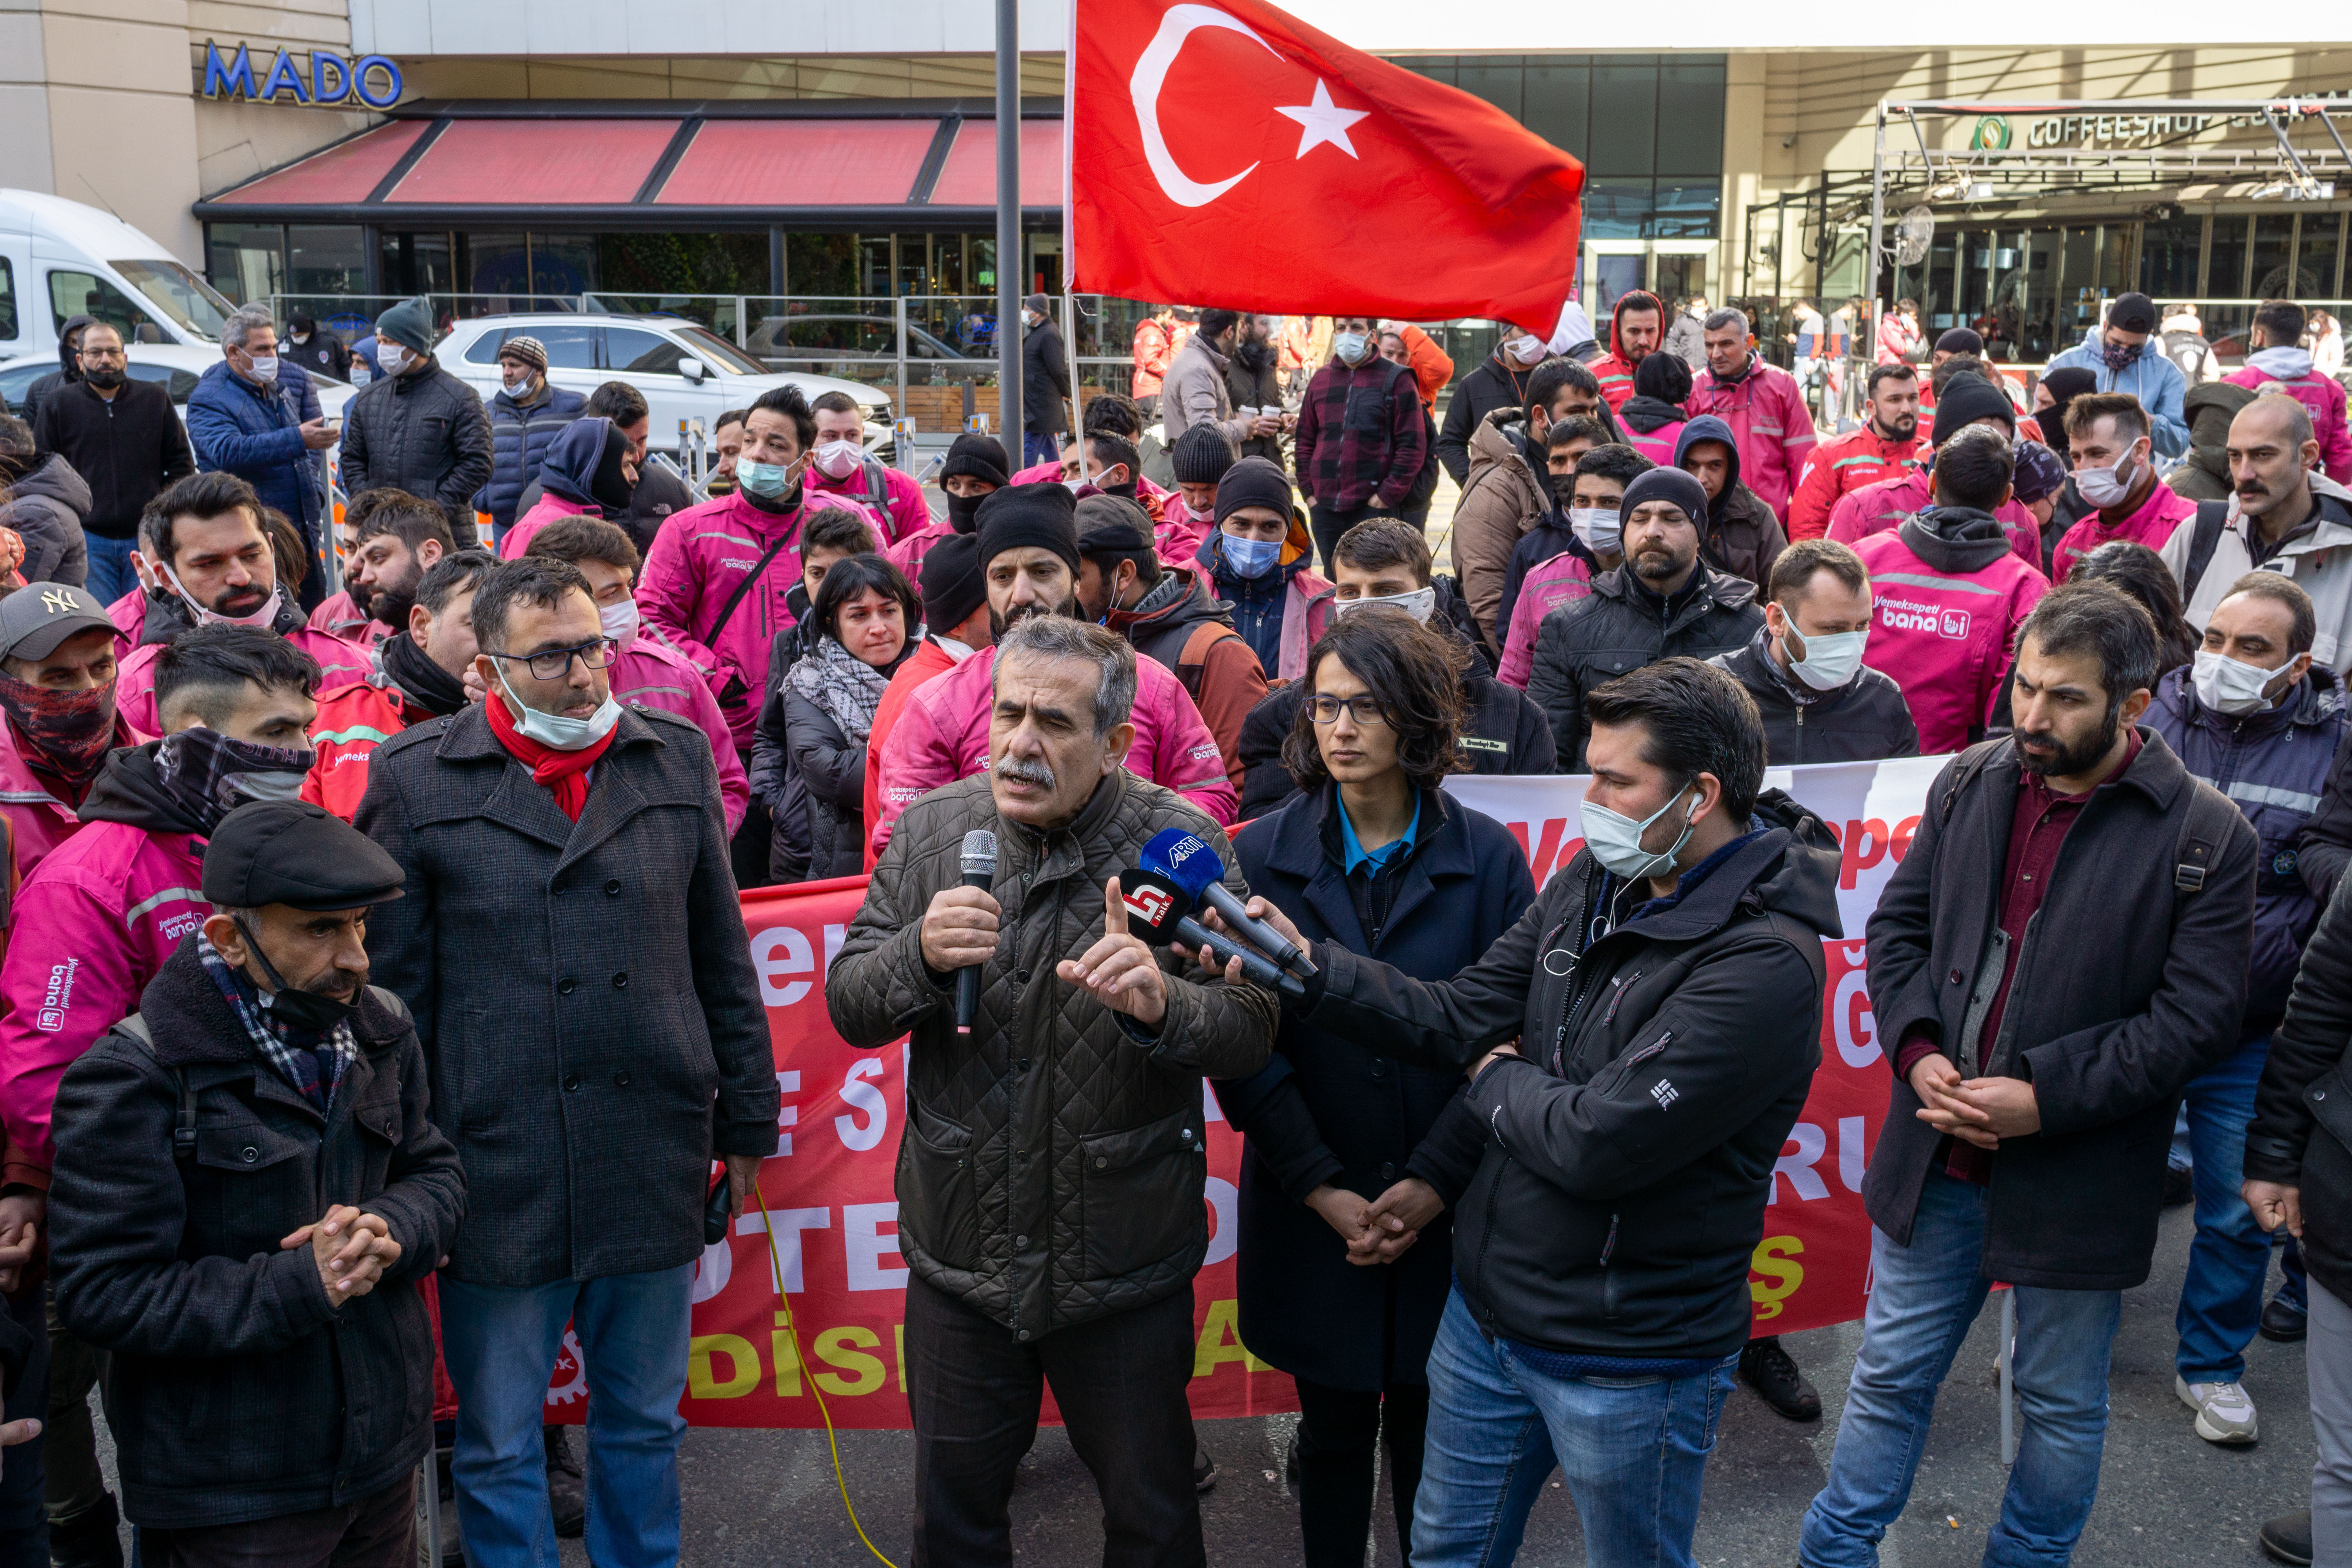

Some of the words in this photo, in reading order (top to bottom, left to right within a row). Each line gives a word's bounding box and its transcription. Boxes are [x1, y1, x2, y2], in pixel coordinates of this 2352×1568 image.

[201, 37, 404, 111] MADO
[332, 320, 366, 331] MADO
[41, 588, 80, 613] NY
[1882, 608, 1937, 632] bana
[1154, 900, 1170, 922] halk
[165, 922, 196, 940] bana
[44, 965, 69, 1007] bana
